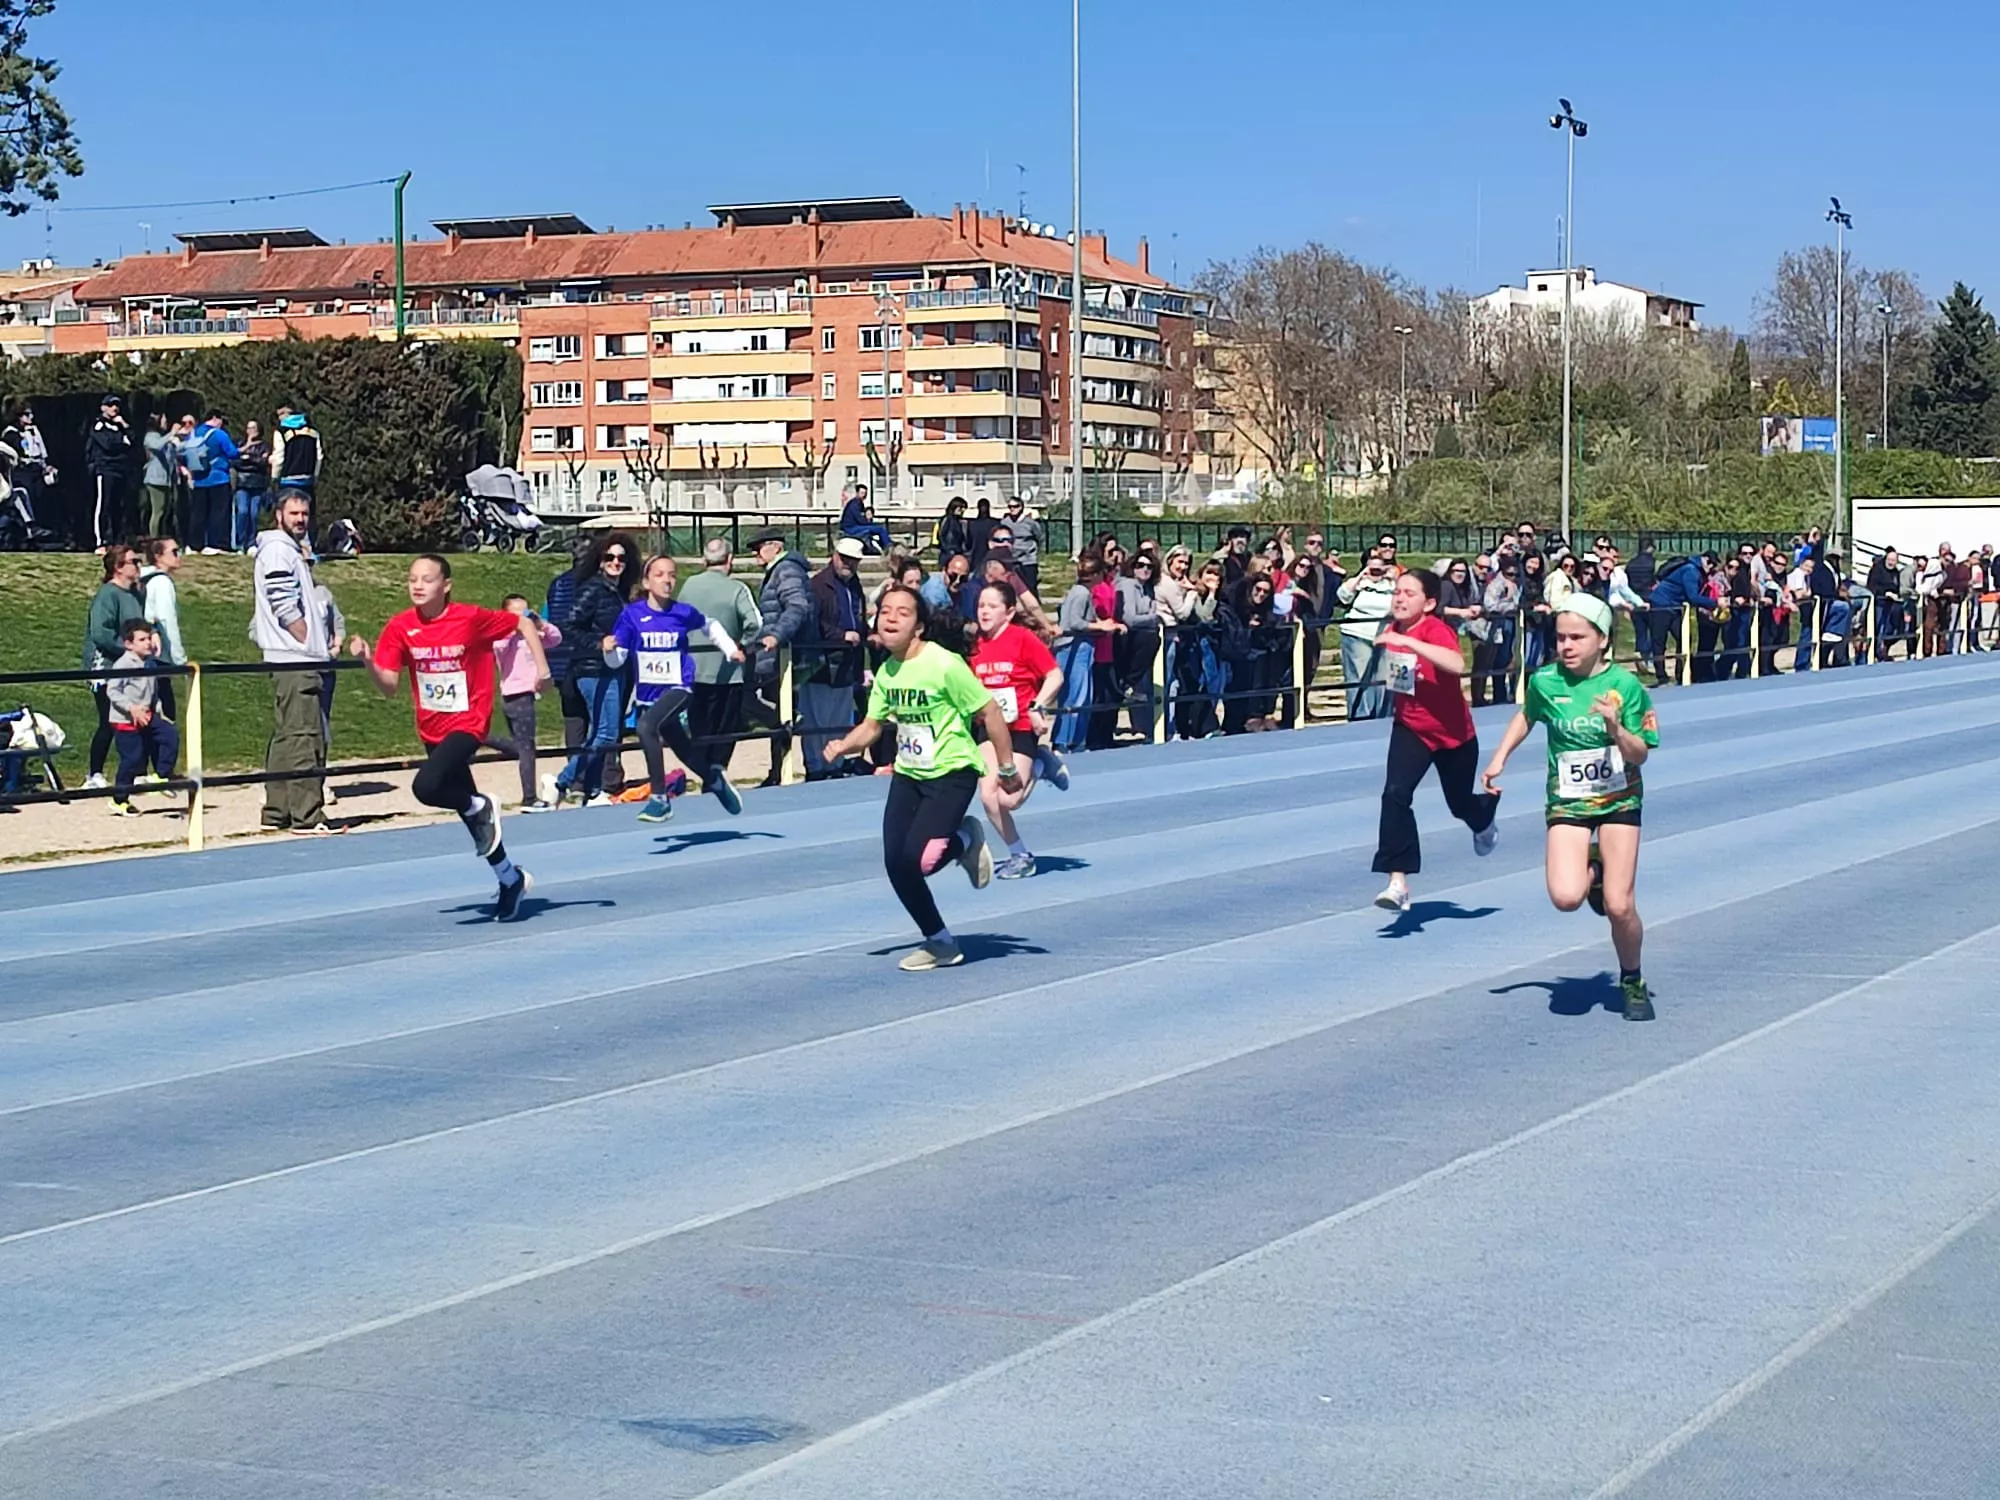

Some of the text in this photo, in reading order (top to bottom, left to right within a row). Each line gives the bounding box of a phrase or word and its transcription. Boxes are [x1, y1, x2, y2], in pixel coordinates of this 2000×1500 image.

[645, 660, 671, 674] 461
[425, 683, 457, 700] 594
[1570, 760, 1613, 783] 506
